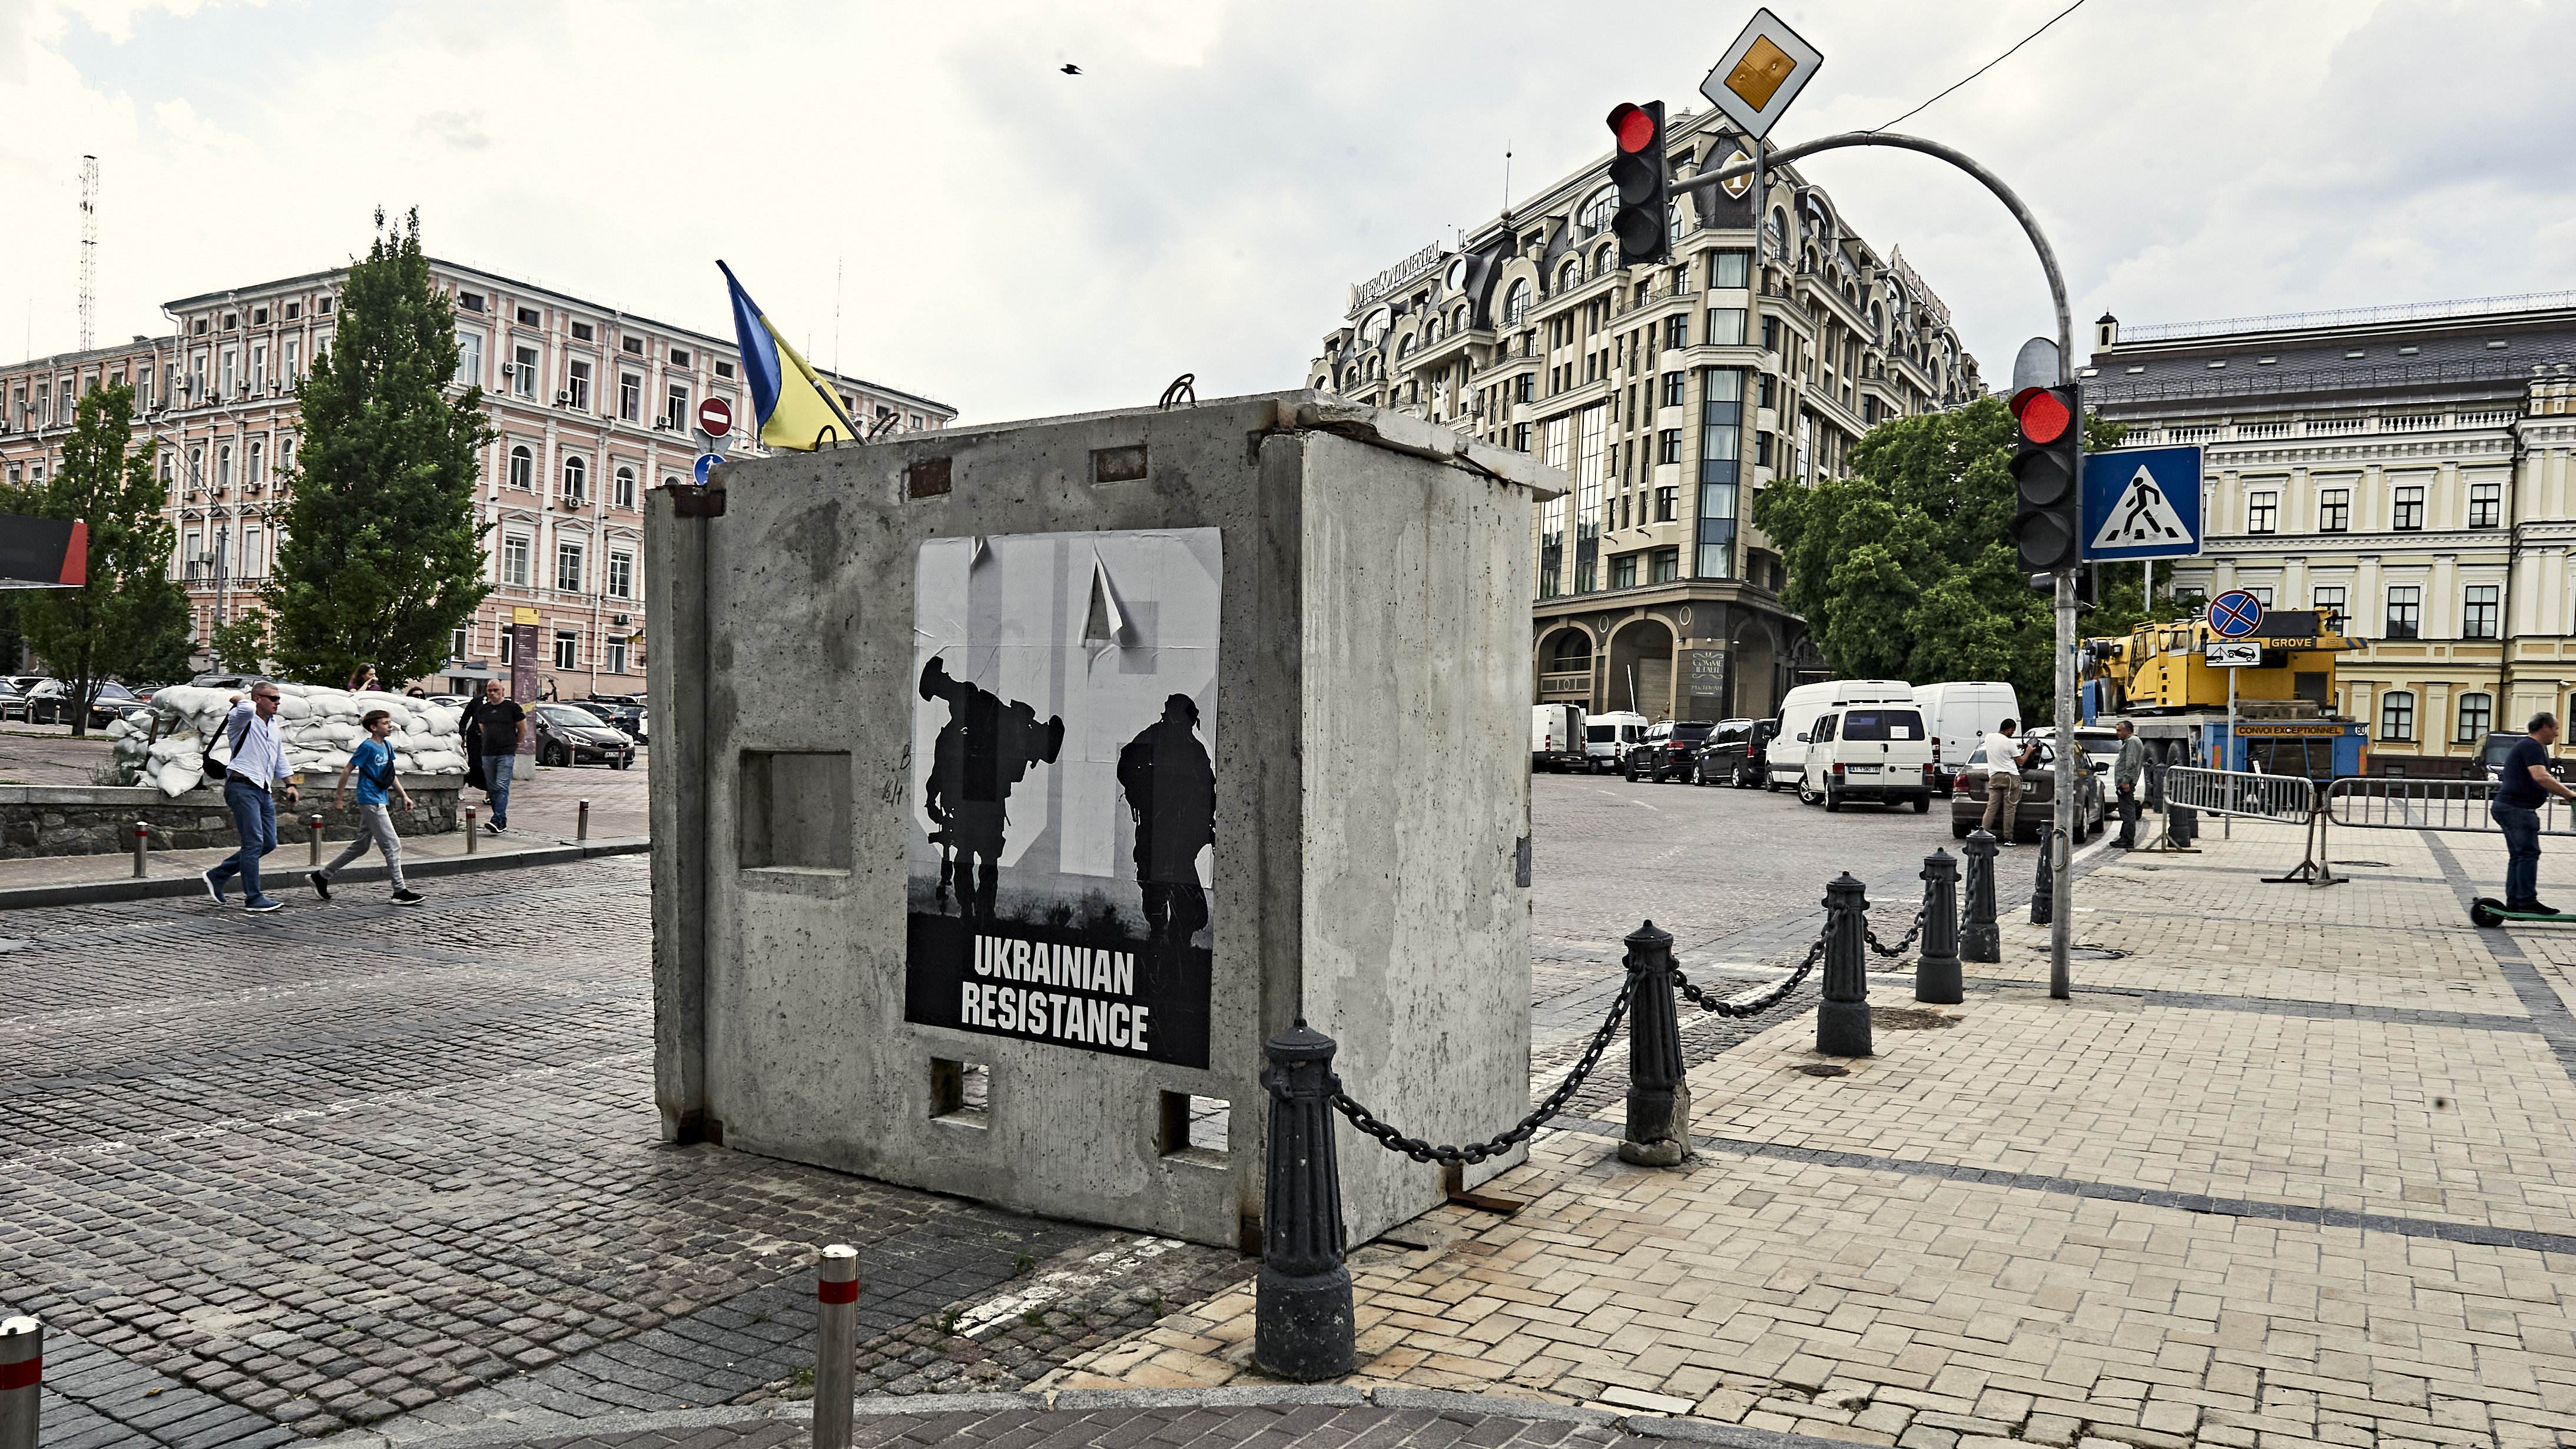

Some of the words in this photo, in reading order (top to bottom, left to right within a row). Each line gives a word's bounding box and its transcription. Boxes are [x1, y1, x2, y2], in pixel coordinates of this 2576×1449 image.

[2271, 638, 2312, 647] GROVE
[2274, 727, 2340, 735] EXCEPTIONNEL
[2357, 725, 2365, 734] 80
[973, 934, 1135, 996] UKRAINIAN
[961, 981, 1149, 1052] RESISTANCE
